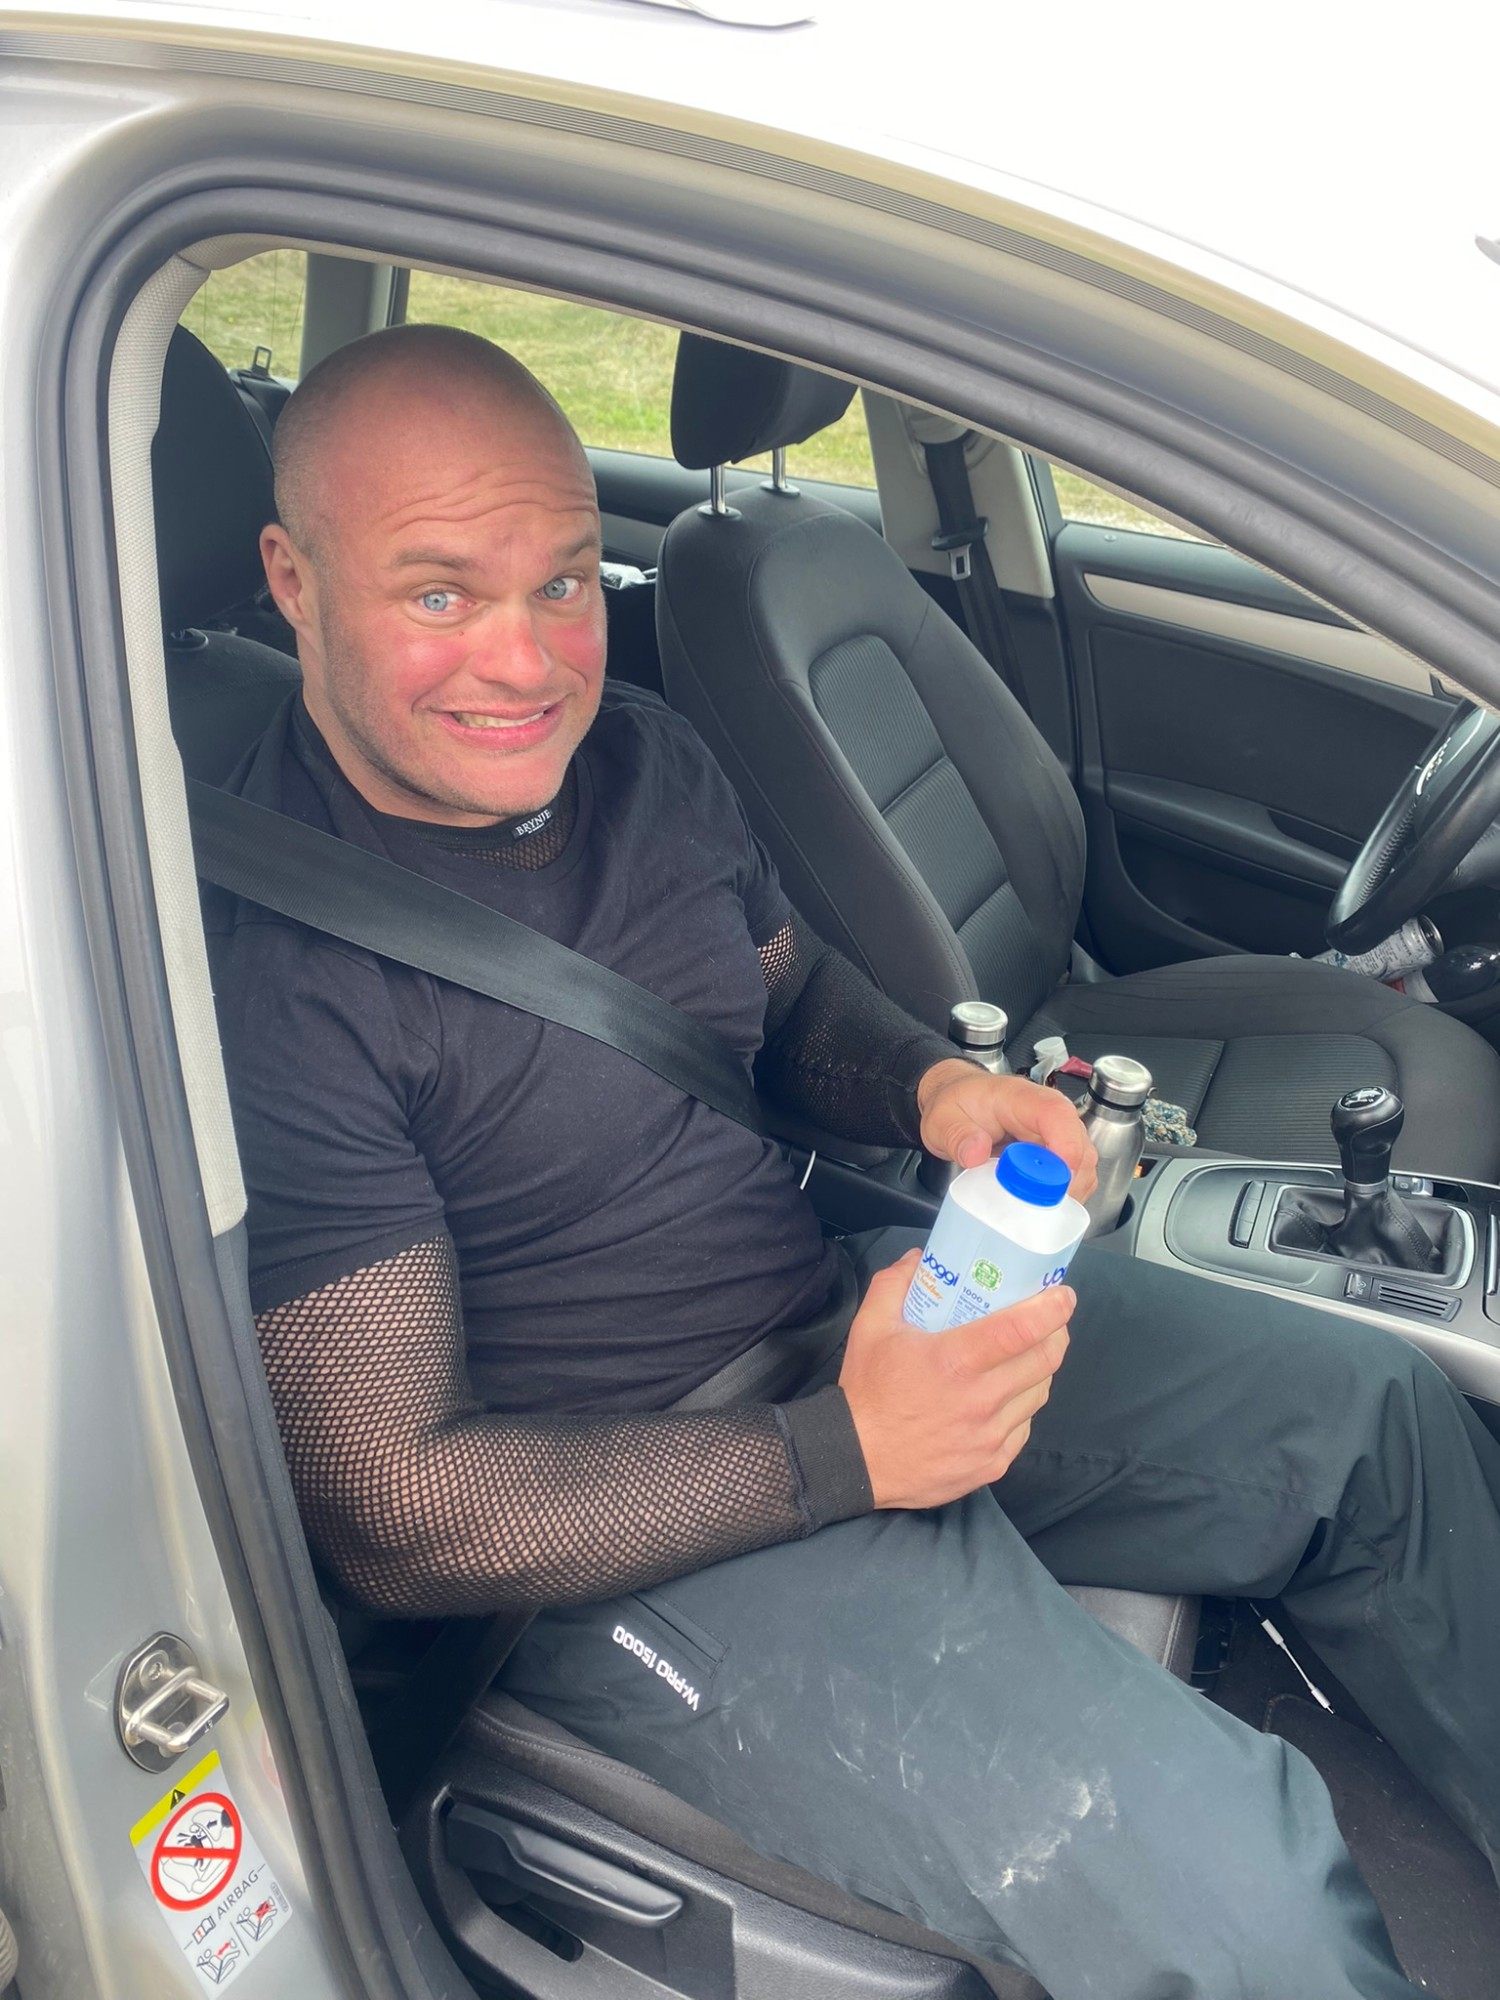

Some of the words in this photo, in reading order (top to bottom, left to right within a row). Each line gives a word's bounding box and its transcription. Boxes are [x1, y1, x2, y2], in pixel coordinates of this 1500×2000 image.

[922, 1245, 960, 1287] yoggi
[963, 1286, 983, 1304] 1000
[612, 1625, 658, 1669] 15000
[655, 1658, 700, 1712] W-PRO
[217, 1869, 259, 1920] AIRBAG
